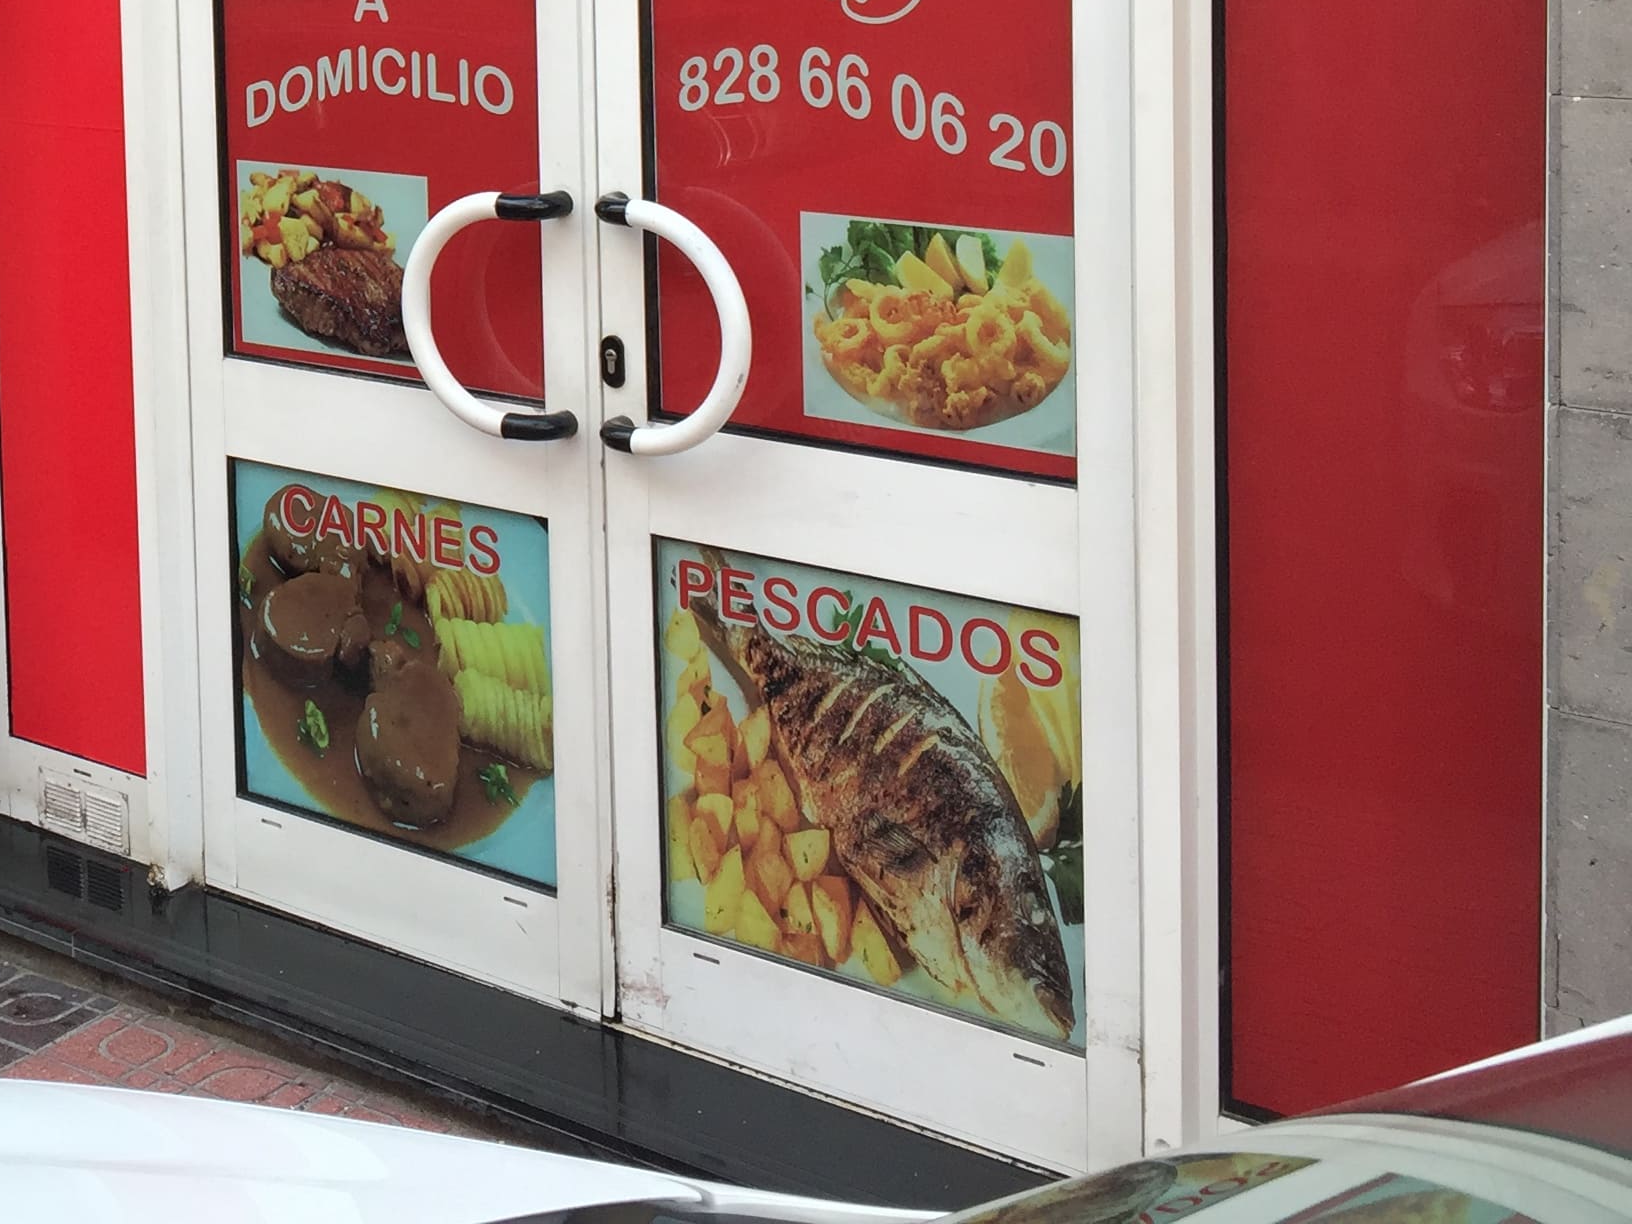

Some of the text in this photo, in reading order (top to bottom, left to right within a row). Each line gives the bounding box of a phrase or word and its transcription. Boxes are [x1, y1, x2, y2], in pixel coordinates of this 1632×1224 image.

[245, 45, 515, 128] DOMICILIO
[678, 44, 1068, 177] 828 66 06 20
[279, 486, 502, 577] CARNES
[674, 558, 1066, 690] PESCADOS
